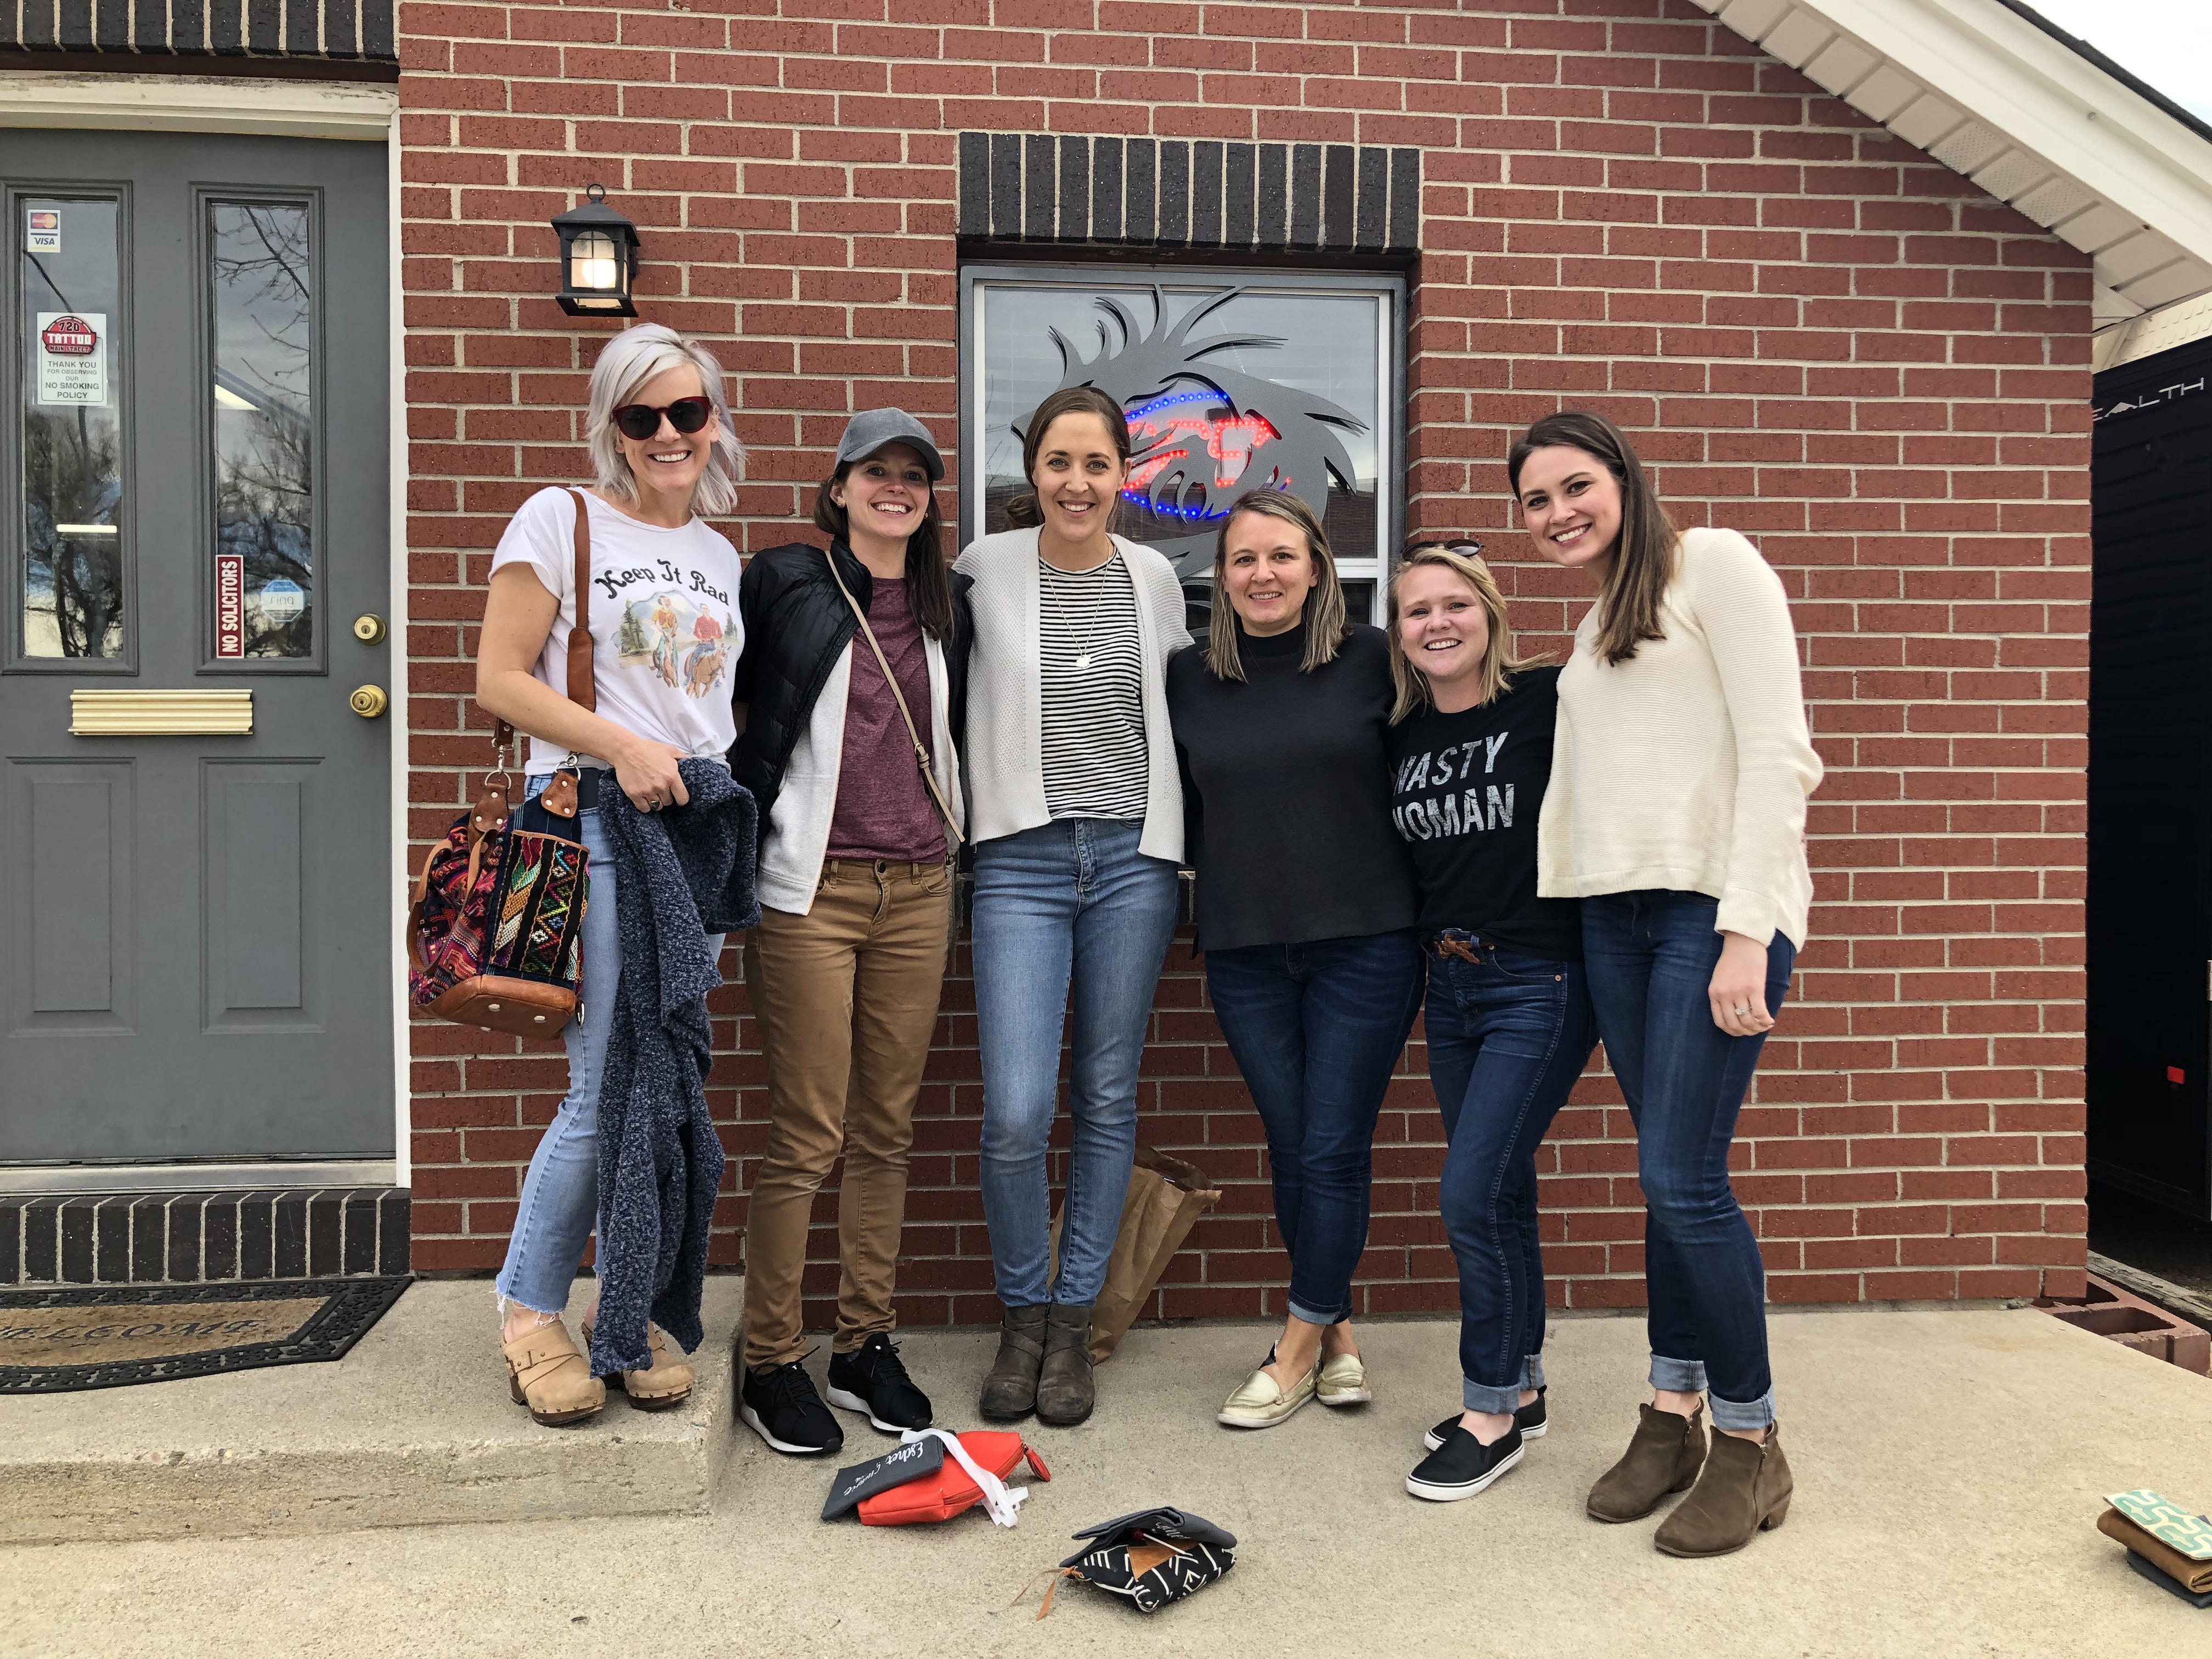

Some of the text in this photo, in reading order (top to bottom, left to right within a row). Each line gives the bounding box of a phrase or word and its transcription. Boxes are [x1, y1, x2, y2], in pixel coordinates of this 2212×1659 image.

[34, 237, 55, 245] VISA
[58, 321, 81, 332] 720
[47, 333, 92, 345] TATTOO
[595, 559, 729, 606] Keep It Rad
[221, 561, 239, 653] NO SOLICITORS
[270, 594, 294, 607] ring
[1393, 731, 1509, 797] NASTY
[0, 1319, 268, 1340] ELCOME
